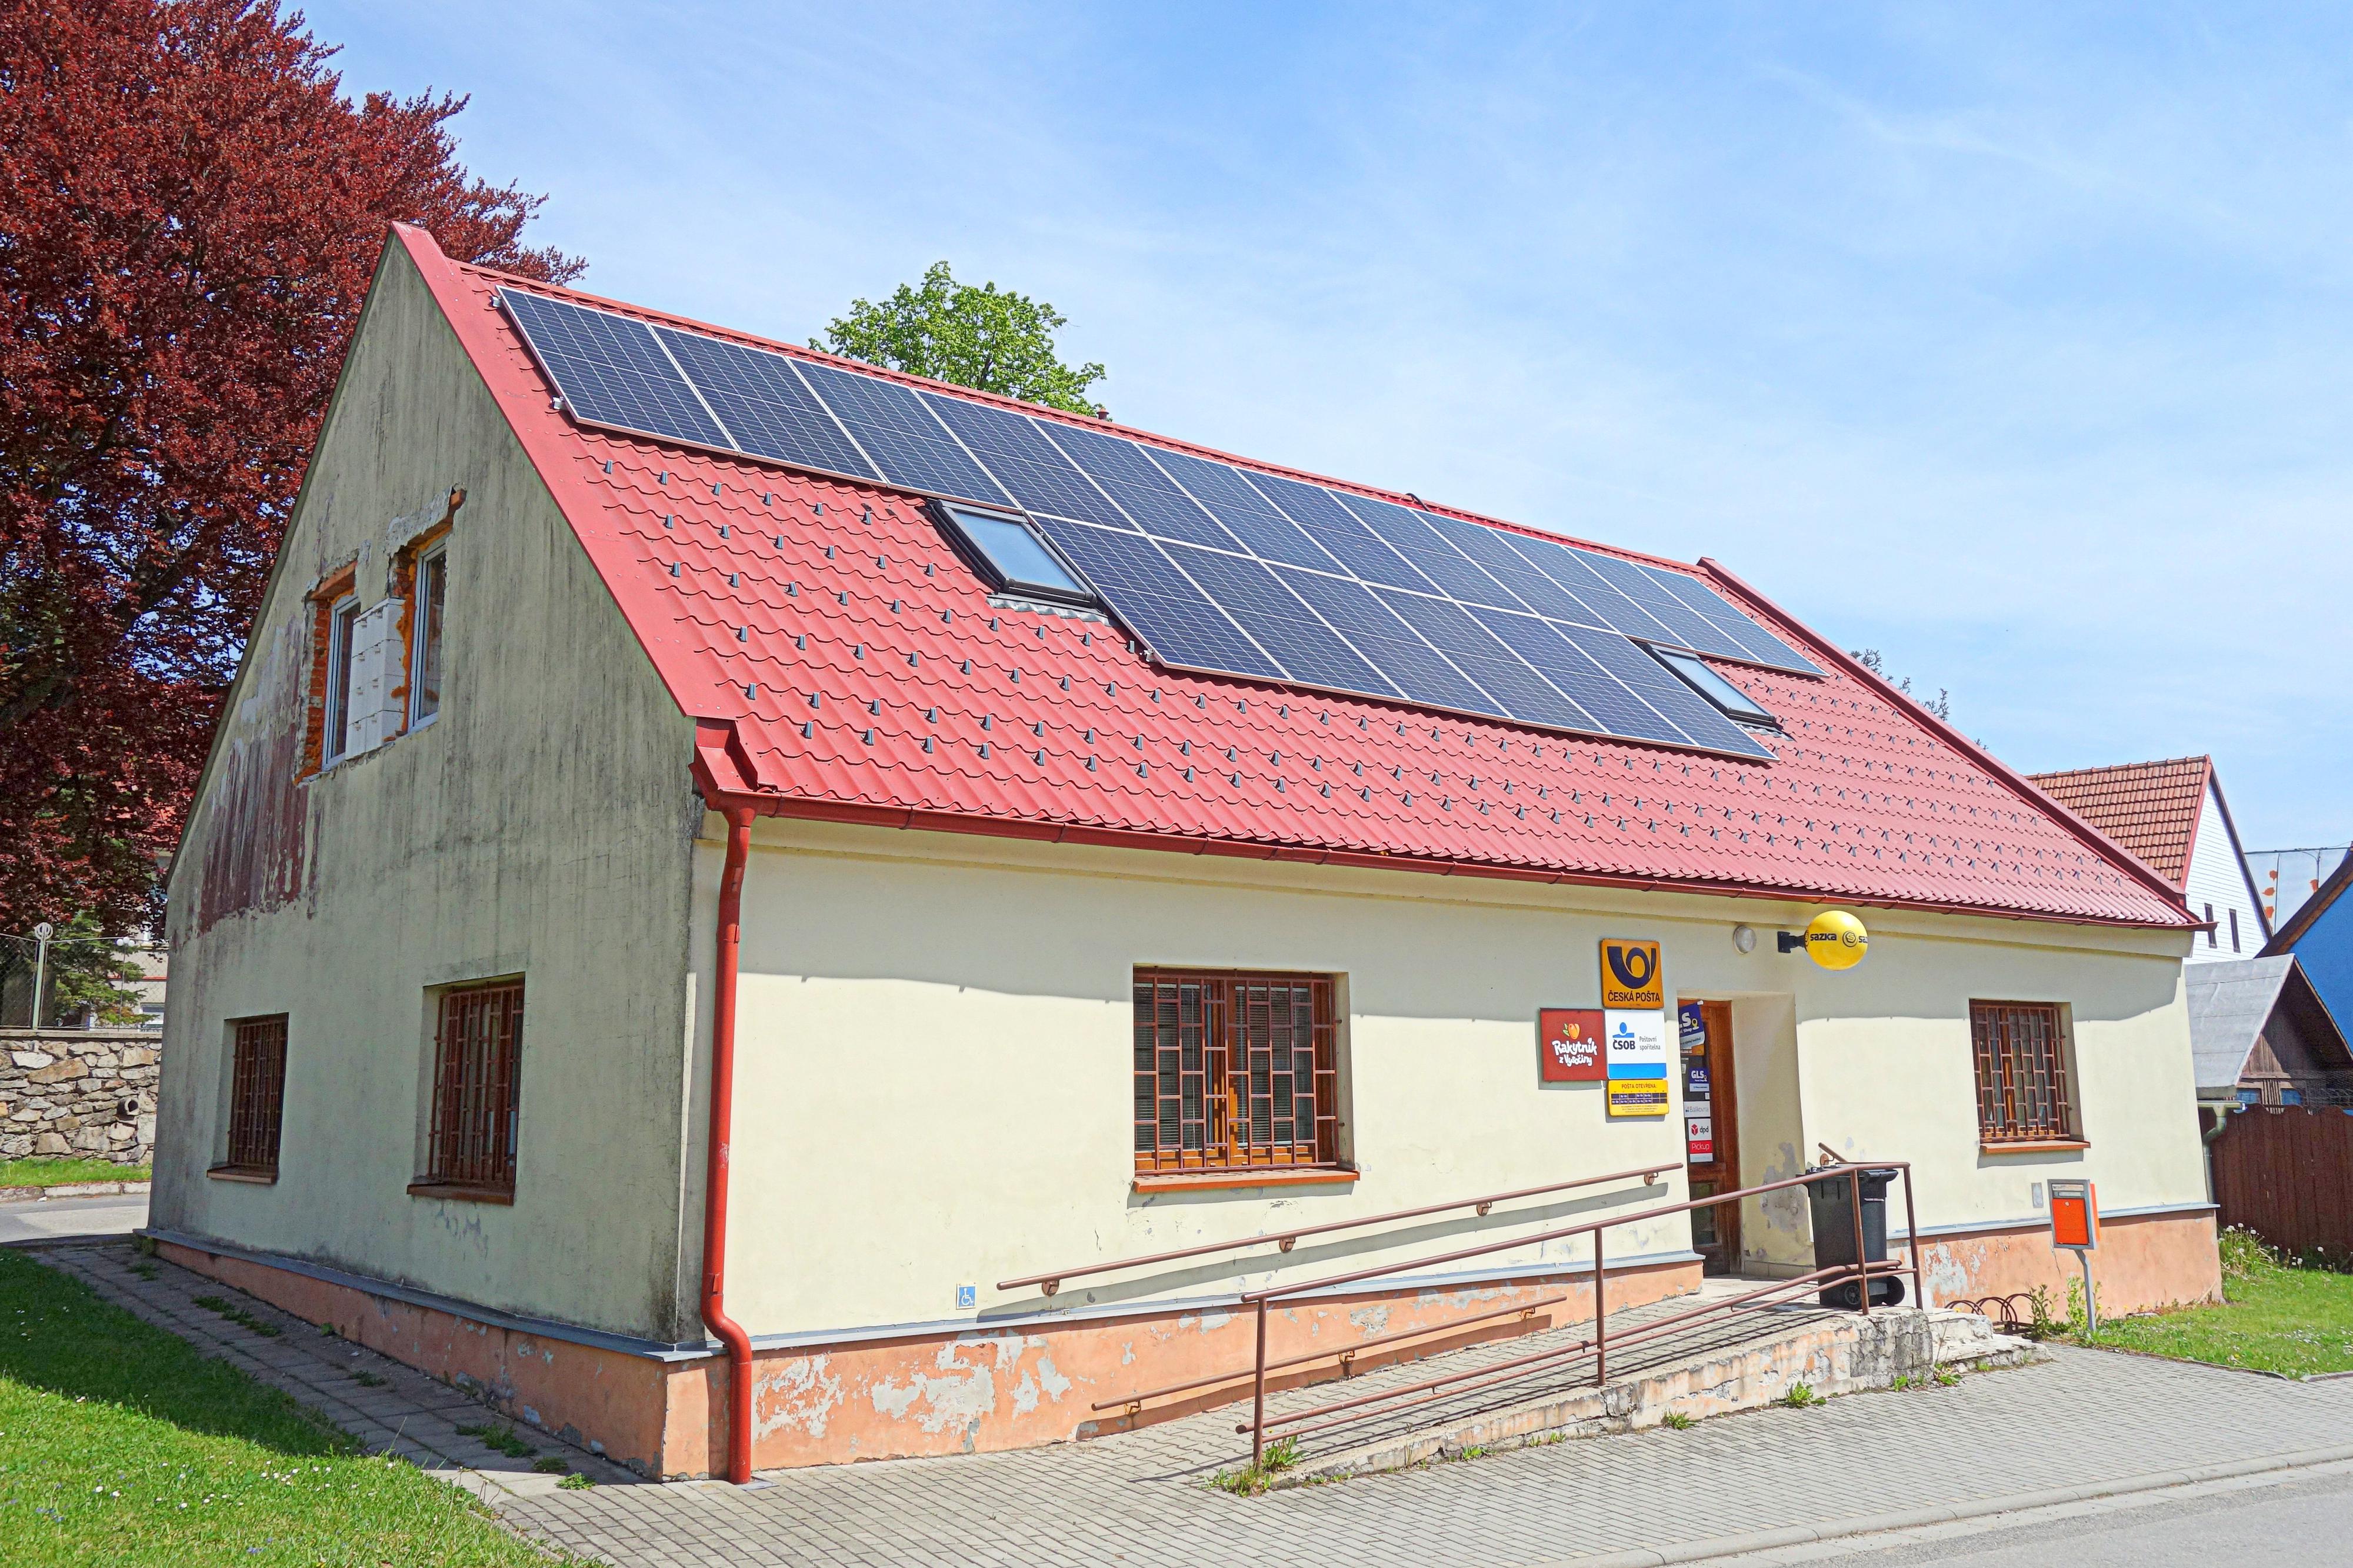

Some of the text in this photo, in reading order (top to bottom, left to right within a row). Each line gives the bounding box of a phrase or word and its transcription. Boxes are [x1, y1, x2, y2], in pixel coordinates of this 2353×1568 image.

[1608, 990, 1661, 1002] ČESKÁ POŠTA
[1552, 1037, 1598, 1056] Rakytník
[1612, 1039, 1636, 1050] ČSOB
[1564, 1054, 1592, 1067] Vysočiny
[1691, 1070, 1704, 1079] GLS
[1699, 1126, 1709, 1134] dpd
[1692, 1143, 1709, 1151] Pickup
